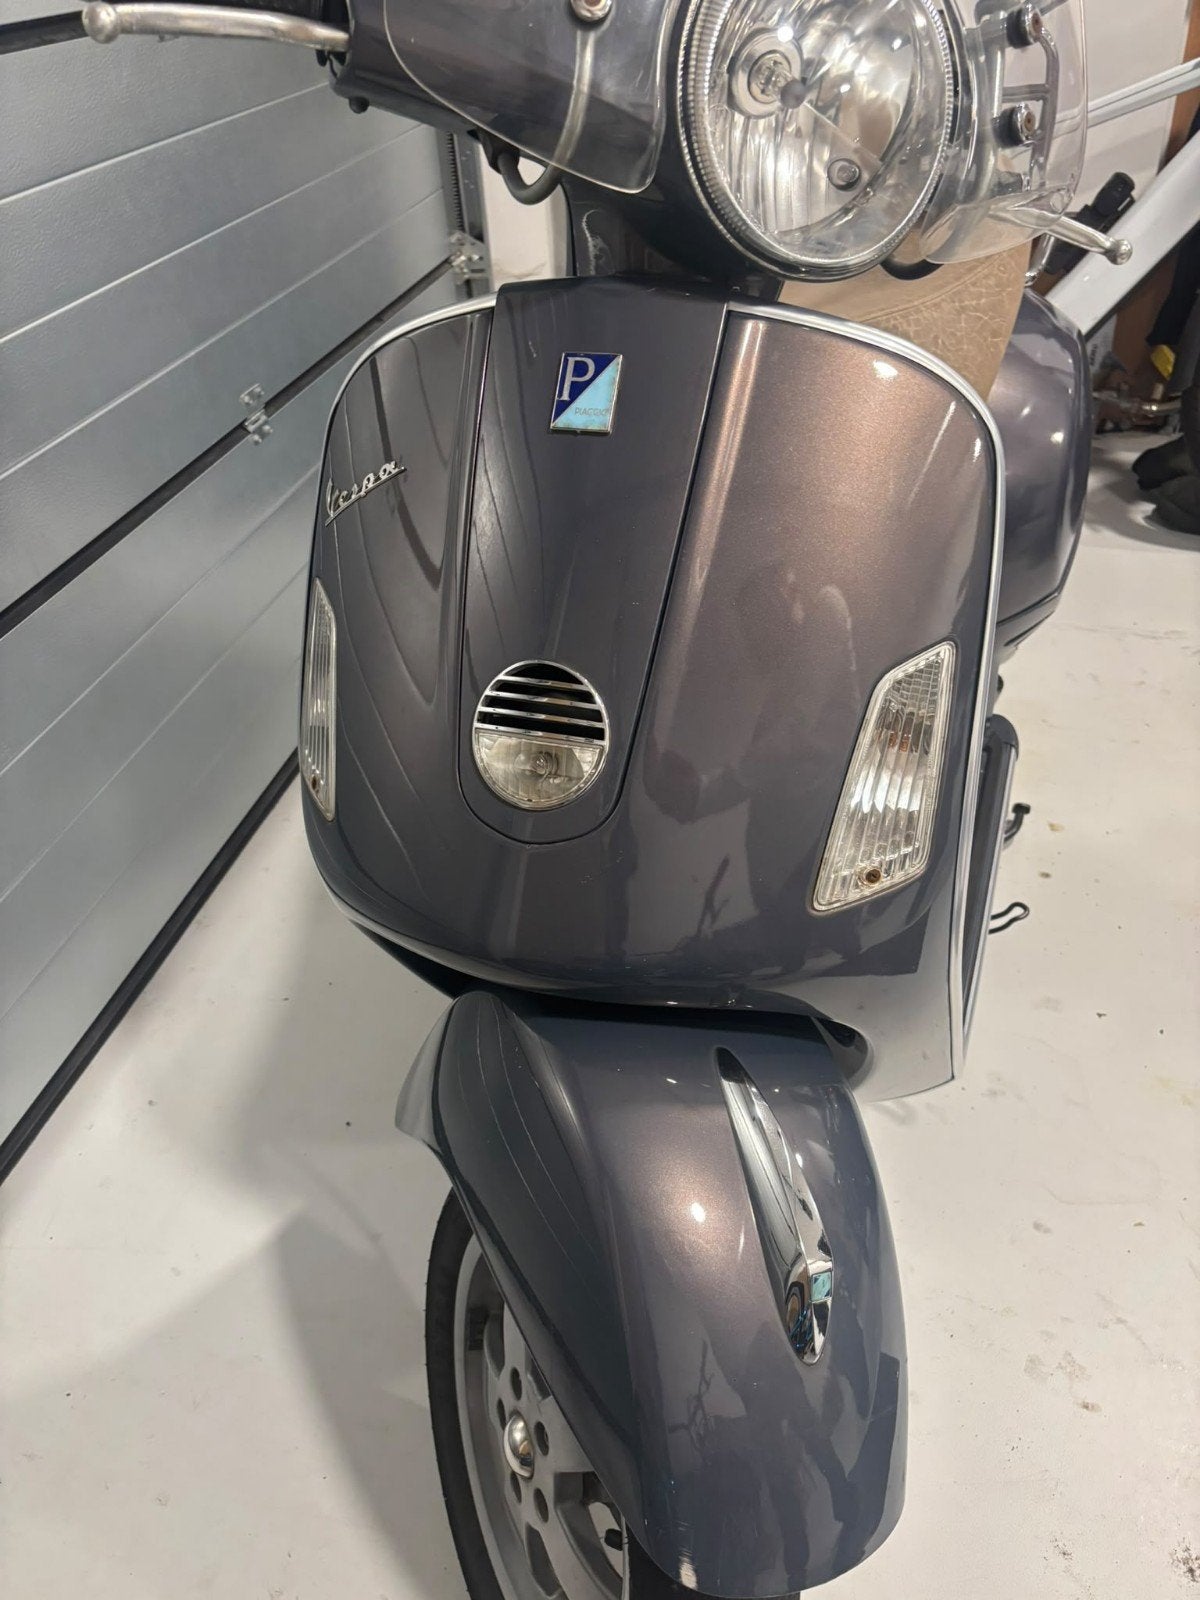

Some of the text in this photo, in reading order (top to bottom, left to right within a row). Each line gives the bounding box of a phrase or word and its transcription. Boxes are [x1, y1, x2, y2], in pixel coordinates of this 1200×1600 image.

[559, 356, 596, 401] P
[574, 407, 609, 416] PIAGGIO
[325, 461, 405, 524] Vespa
